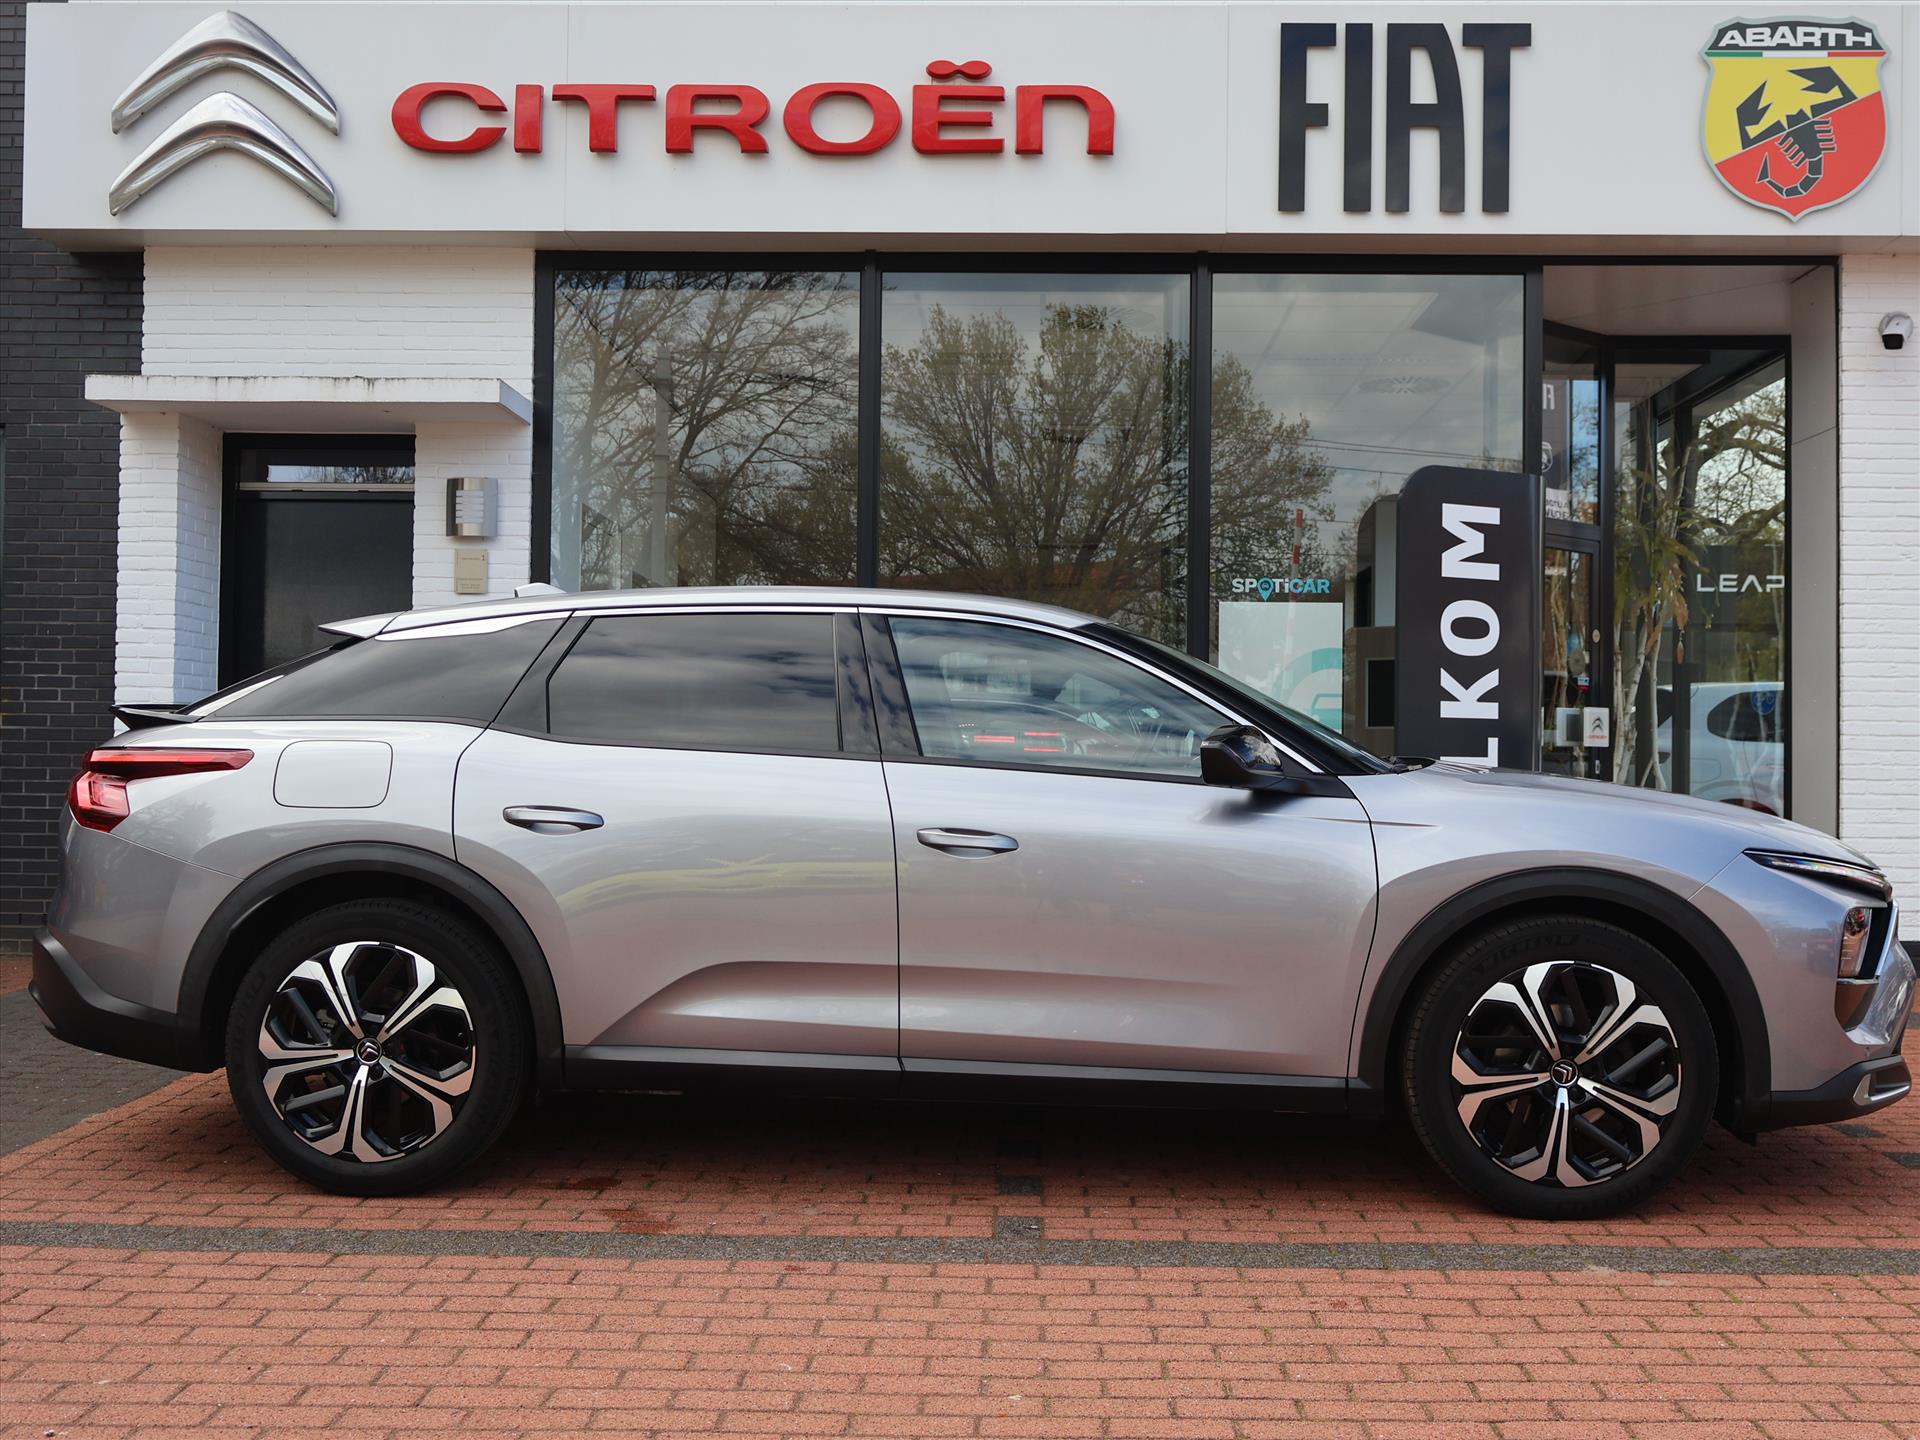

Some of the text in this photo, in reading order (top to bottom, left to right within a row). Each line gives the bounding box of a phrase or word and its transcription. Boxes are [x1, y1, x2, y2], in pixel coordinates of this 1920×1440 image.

[1718, 25, 1873, 47] ABARTH
[1278, 23, 1532, 213] FIAT
[1440, 503, 1501, 768] LKOM
[1696, 574, 1785, 592] LEAP
